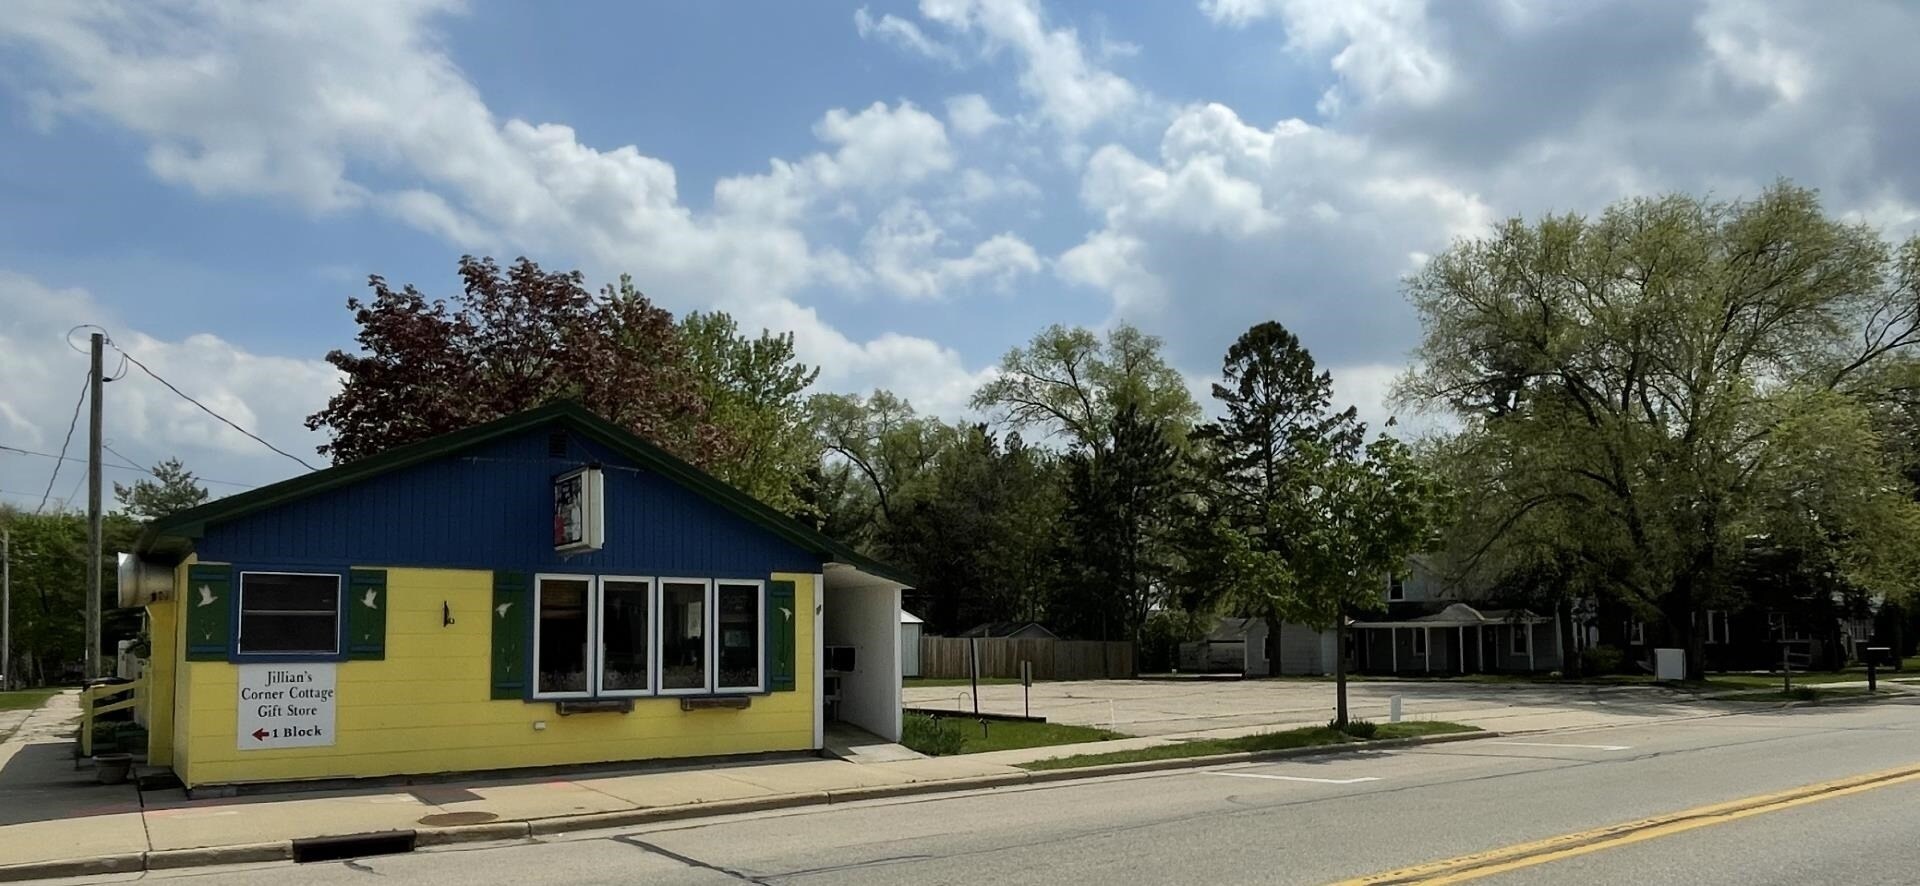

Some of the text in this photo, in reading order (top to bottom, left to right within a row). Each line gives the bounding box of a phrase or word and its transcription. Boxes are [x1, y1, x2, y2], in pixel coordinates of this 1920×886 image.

[265, 671, 312, 687] Jillian's
[241, 687, 334, 702] Corner Cottage
[258, 705, 317, 717] Gift Store
[273, 725, 322, 738] 1 Block
